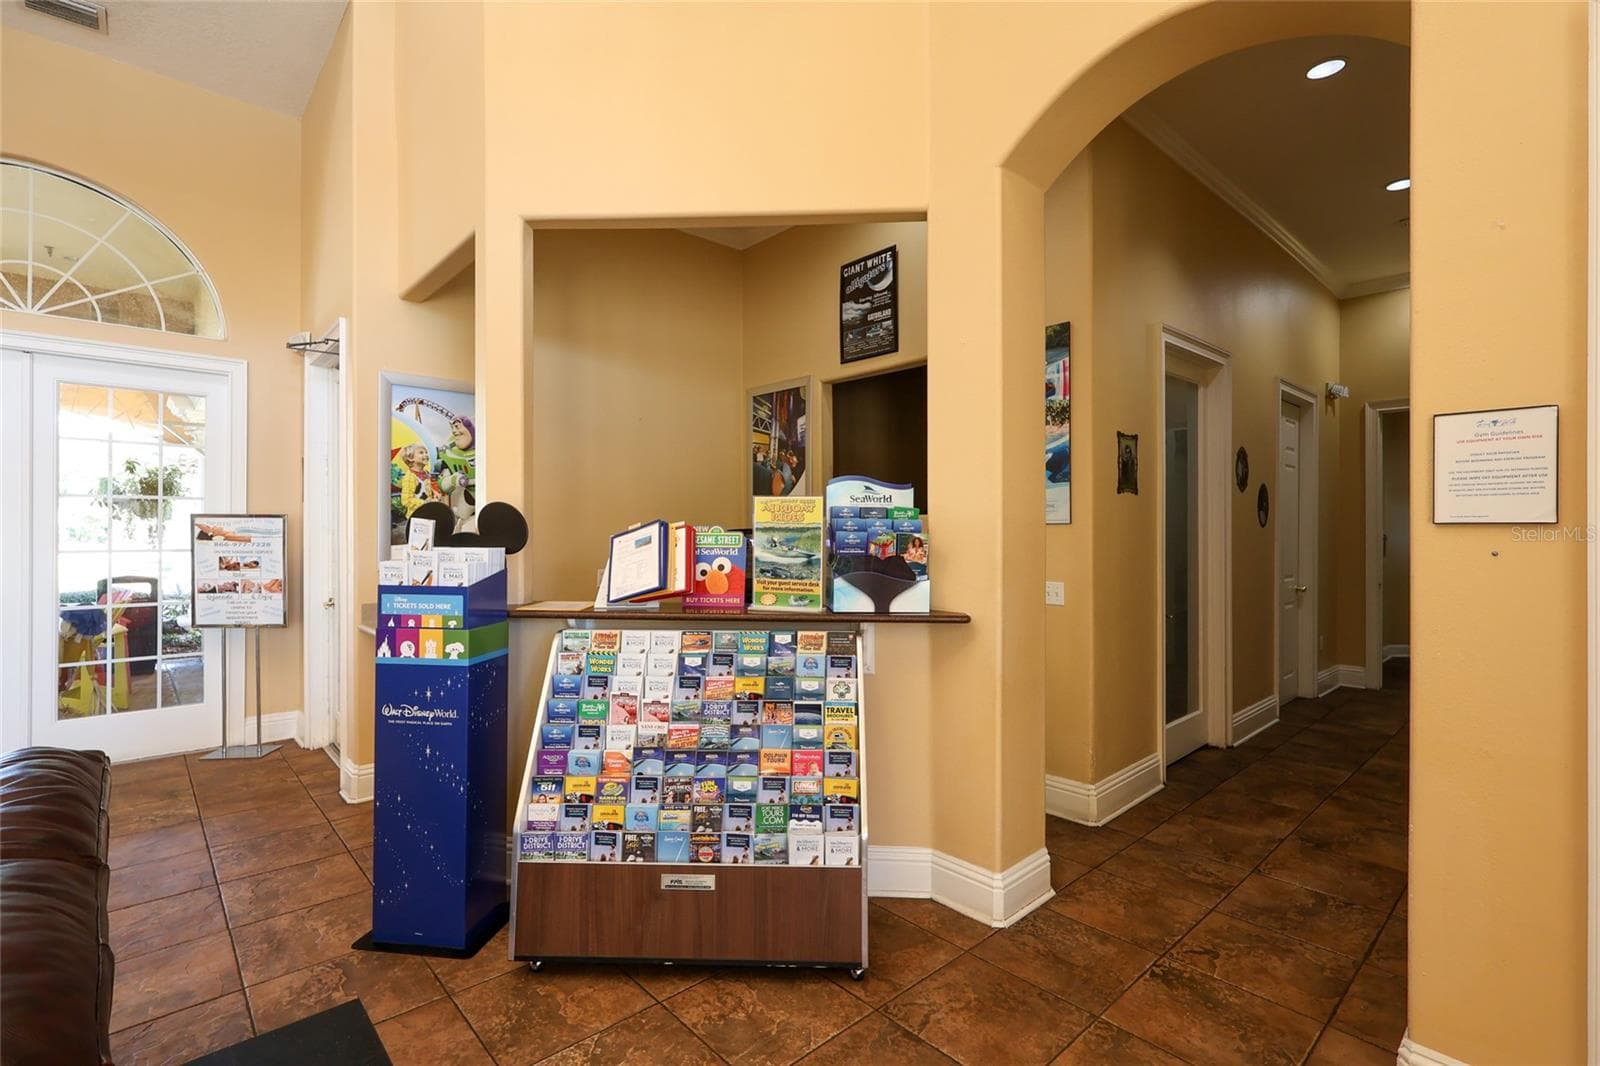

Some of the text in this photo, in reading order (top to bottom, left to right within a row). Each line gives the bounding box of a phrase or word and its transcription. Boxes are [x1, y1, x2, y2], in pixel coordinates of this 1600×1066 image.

[843, 251, 892, 278] GIANT WHITE
[849, 494, 893, 504] SeaWorld
[760, 503, 817, 514] AIRBOAT
[770, 512, 806, 522] RIDES
[696, 535, 739, 545] ESAME STREET
[701, 547, 739, 556] SeaWorld
[591, 665, 612, 673] WORKS
[434, 708, 457, 719] World
[826, 706, 854, 714] TRAVEL
[523, 842, 551, 850] DISTRICT
